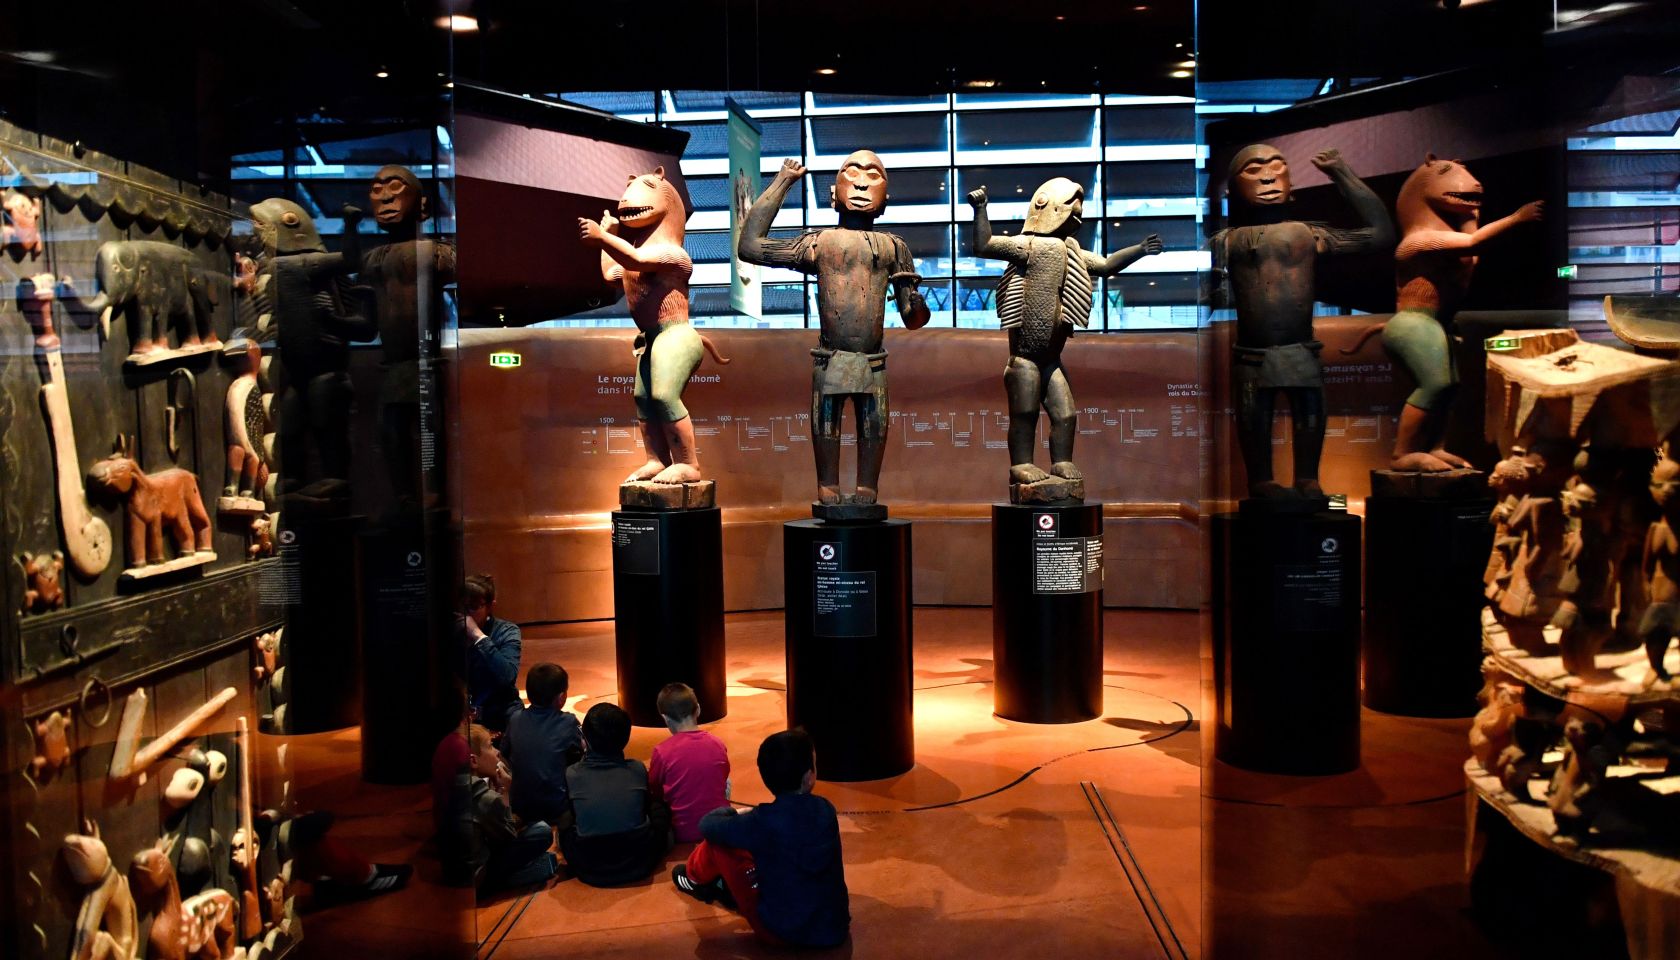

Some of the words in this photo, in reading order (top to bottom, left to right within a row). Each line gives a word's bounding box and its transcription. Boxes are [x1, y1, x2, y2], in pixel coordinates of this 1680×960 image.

[598, 375, 609, 383] Le
[613, 376, 634, 384] roya
[689, 374, 720, 383] nhomè
[598, 386, 620, 394] dans
